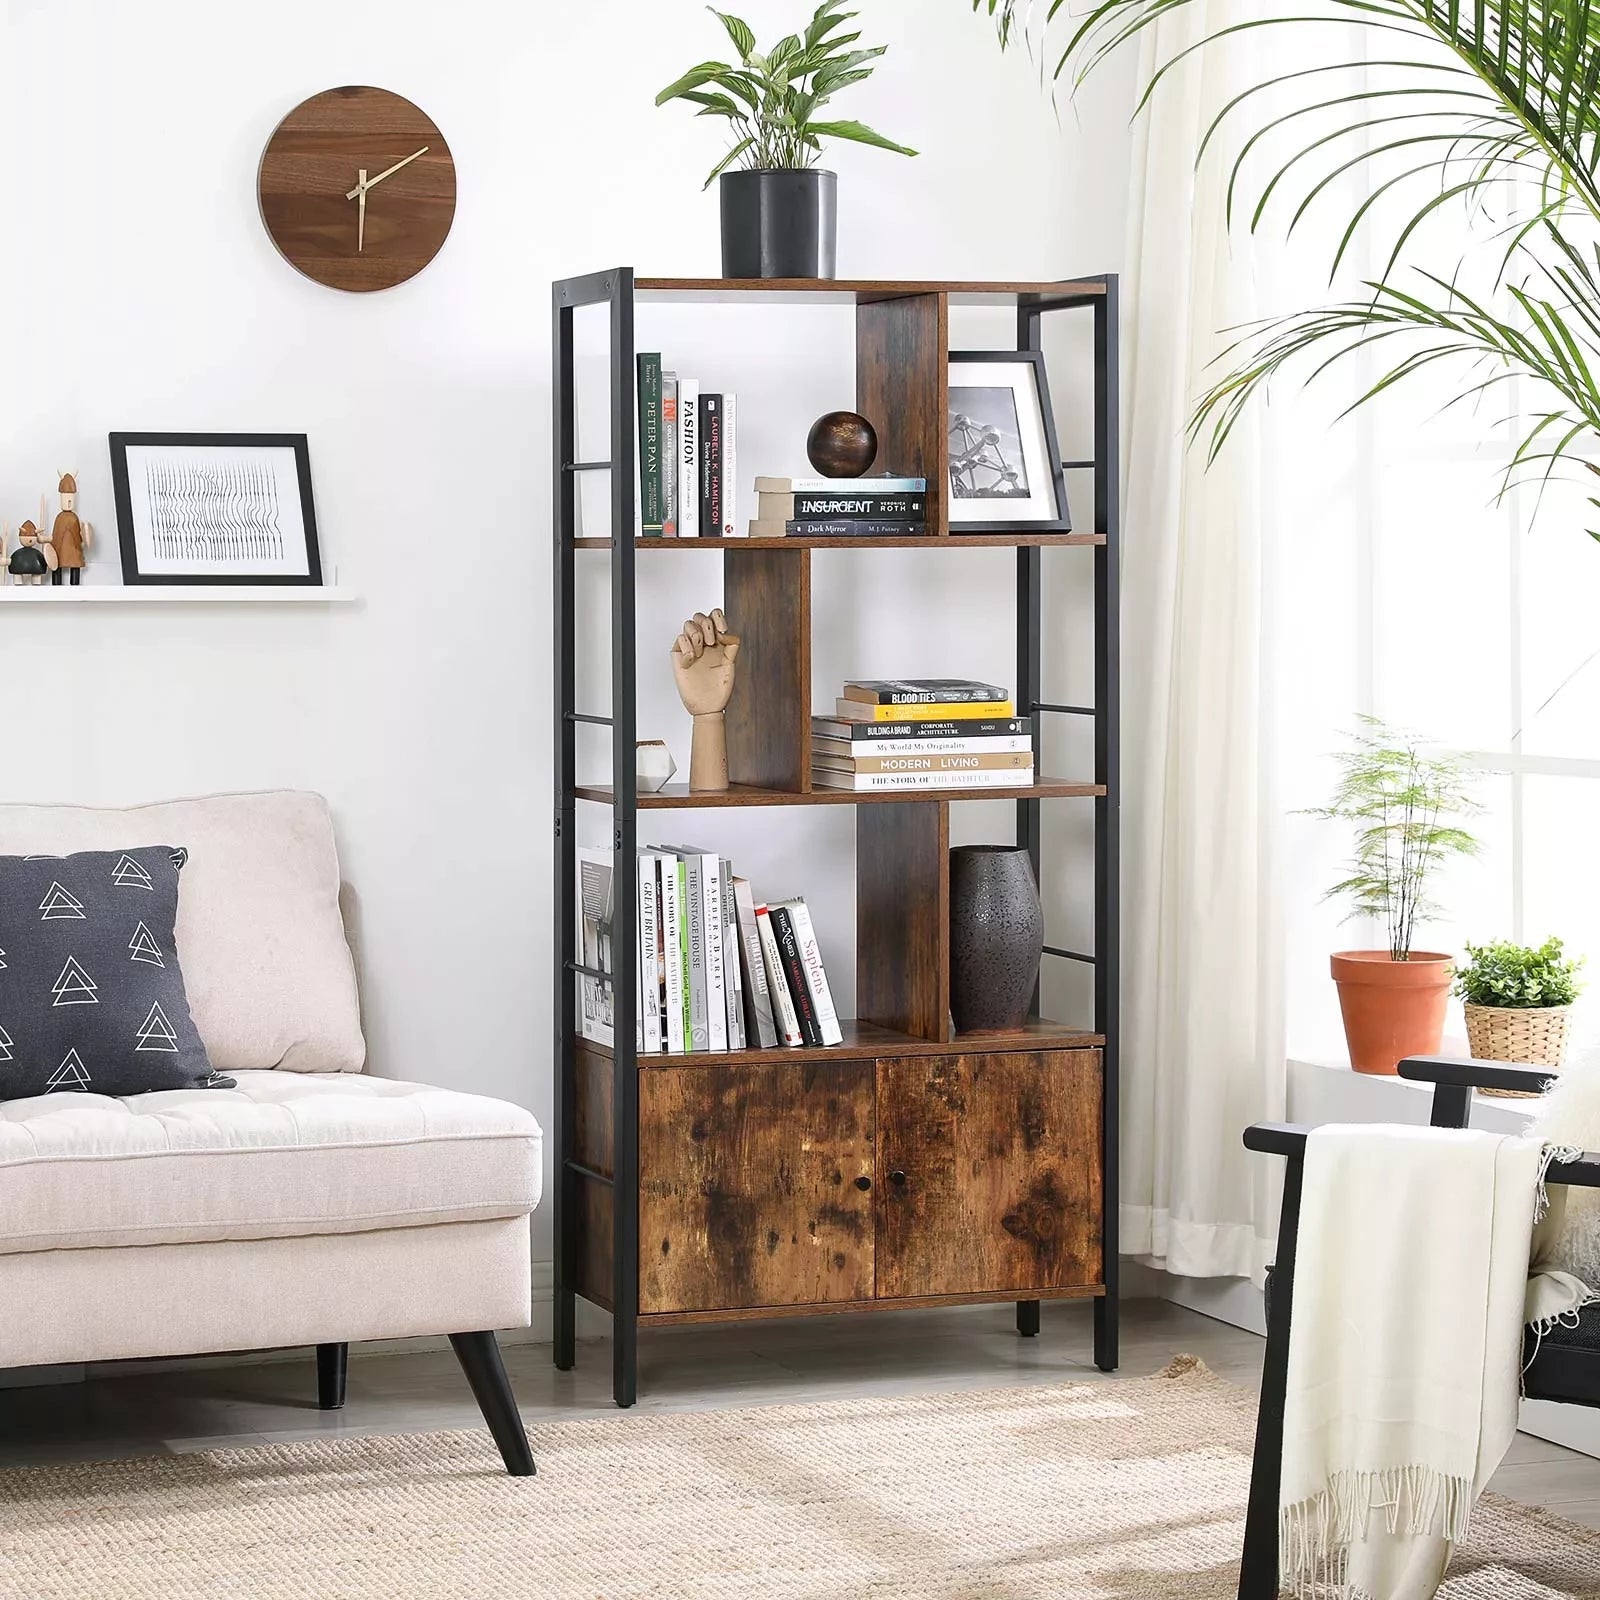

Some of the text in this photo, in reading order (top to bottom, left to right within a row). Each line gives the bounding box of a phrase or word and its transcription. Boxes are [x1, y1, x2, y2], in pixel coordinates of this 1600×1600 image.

[648, 402, 656, 444] PETER
[664, 398, 675, 422] IN!
[684, 401, 694, 466] FASHION
[648, 446, 657, 473] PAN
[712, 463, 718, 472] K.
[802, 500, 874, 513] INSURGENT
[808, 525, 846, 533] Dark Mirror
[892, 694, 918, 704] BLOOD
[919, 692, 936, 702] TIES
[868, 727, 890, 736] BUILDING
[894, 726, 912, 735] BRAND
[926, 742, 965, 750] Originality
[880, 758, 979, 770] MODERN LIVING
[644, 882, 653, 914] GREAT
[690, 891, 699, 934] VINTAGE
[711, 878, 719, 940] BARBERA
[645, 918, 654, 960] BRITAIN
[670, 926, 676, 938] OF
[779, 913, 795, 957] THE NAMED
[692, 936, 700, 968] HOUSE
[792, 960, 804, 992] MARIANNE
[804, 940, 824, 995] Sapiens
